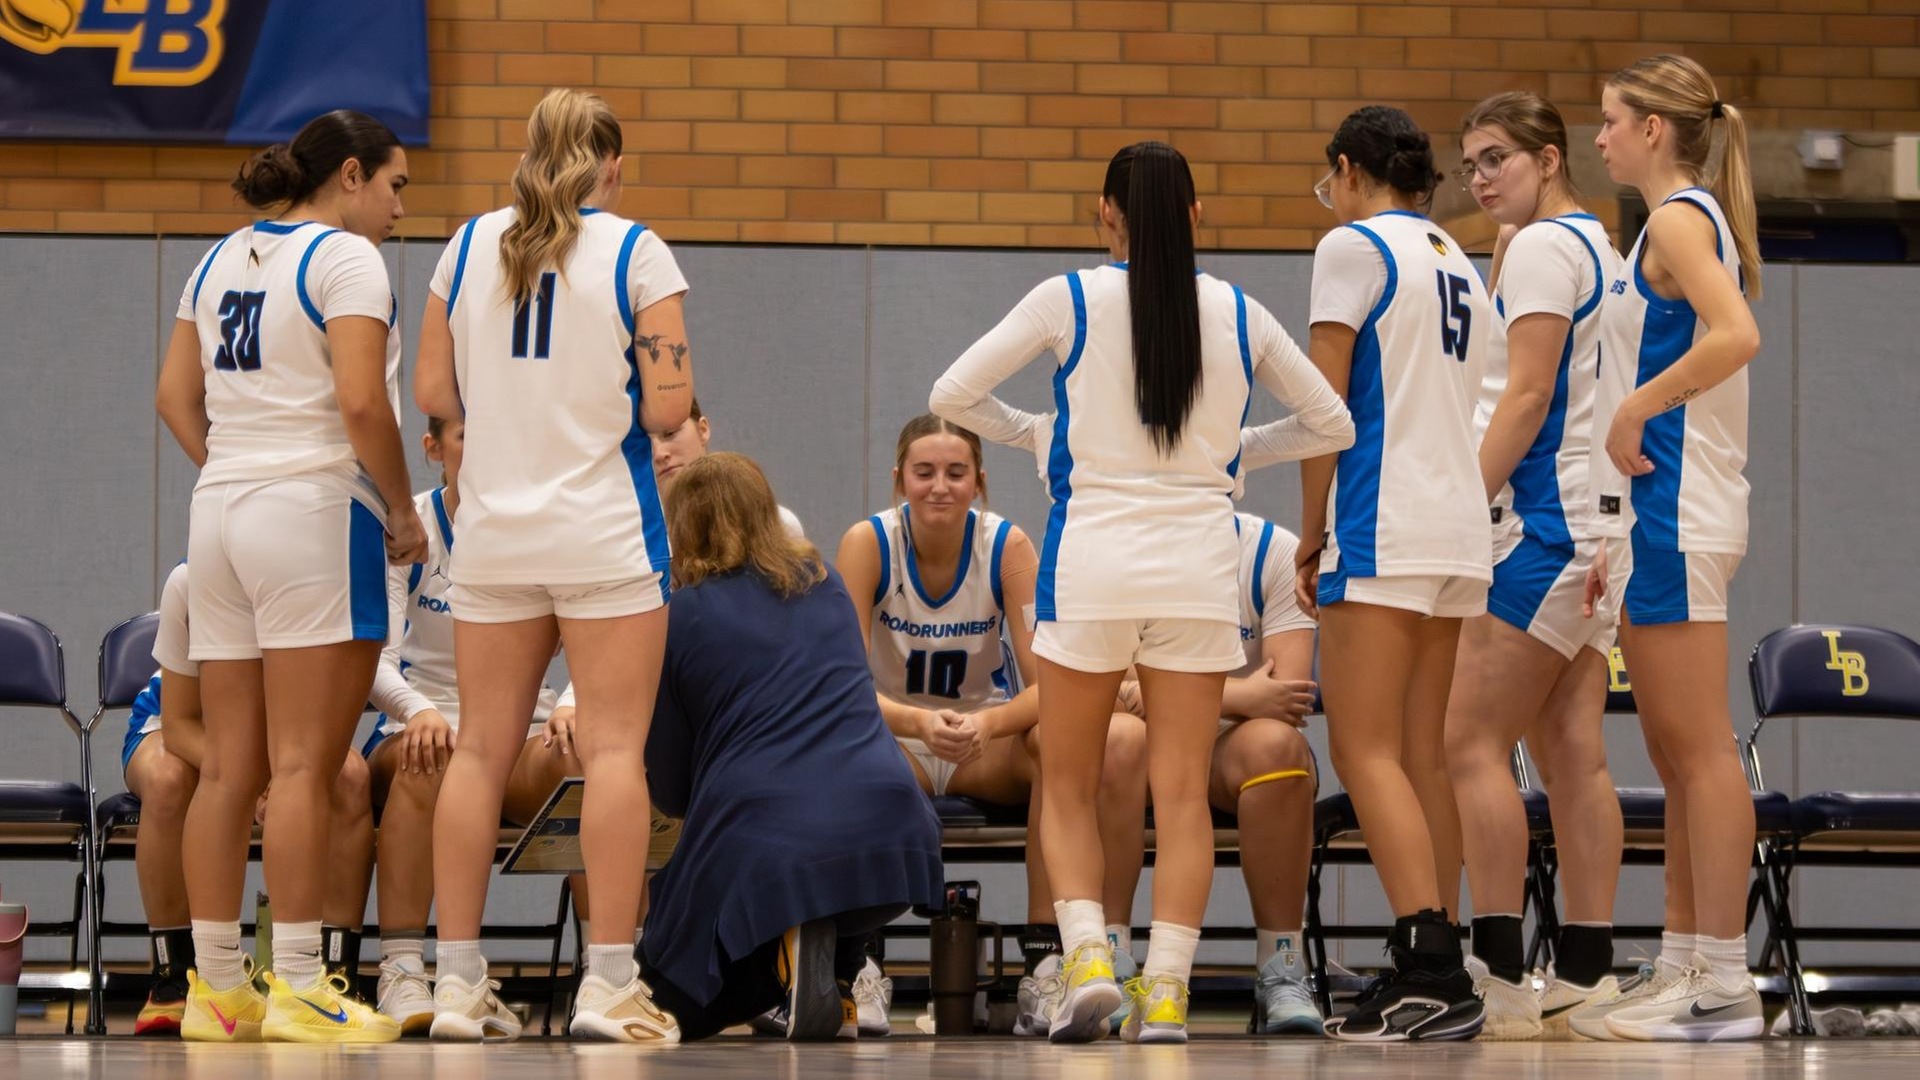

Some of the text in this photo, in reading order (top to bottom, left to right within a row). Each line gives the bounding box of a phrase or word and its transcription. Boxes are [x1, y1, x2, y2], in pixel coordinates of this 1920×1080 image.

[214, 290, 266, 371] 30
[511, 272, 557, 359] 11
[1436, 268, 1471, 362] 15
[880, 610, 996, 639] ROADRUNNERS
[905, 649, 968, 699] 10
[1821, 630, 1869, 696] LB
